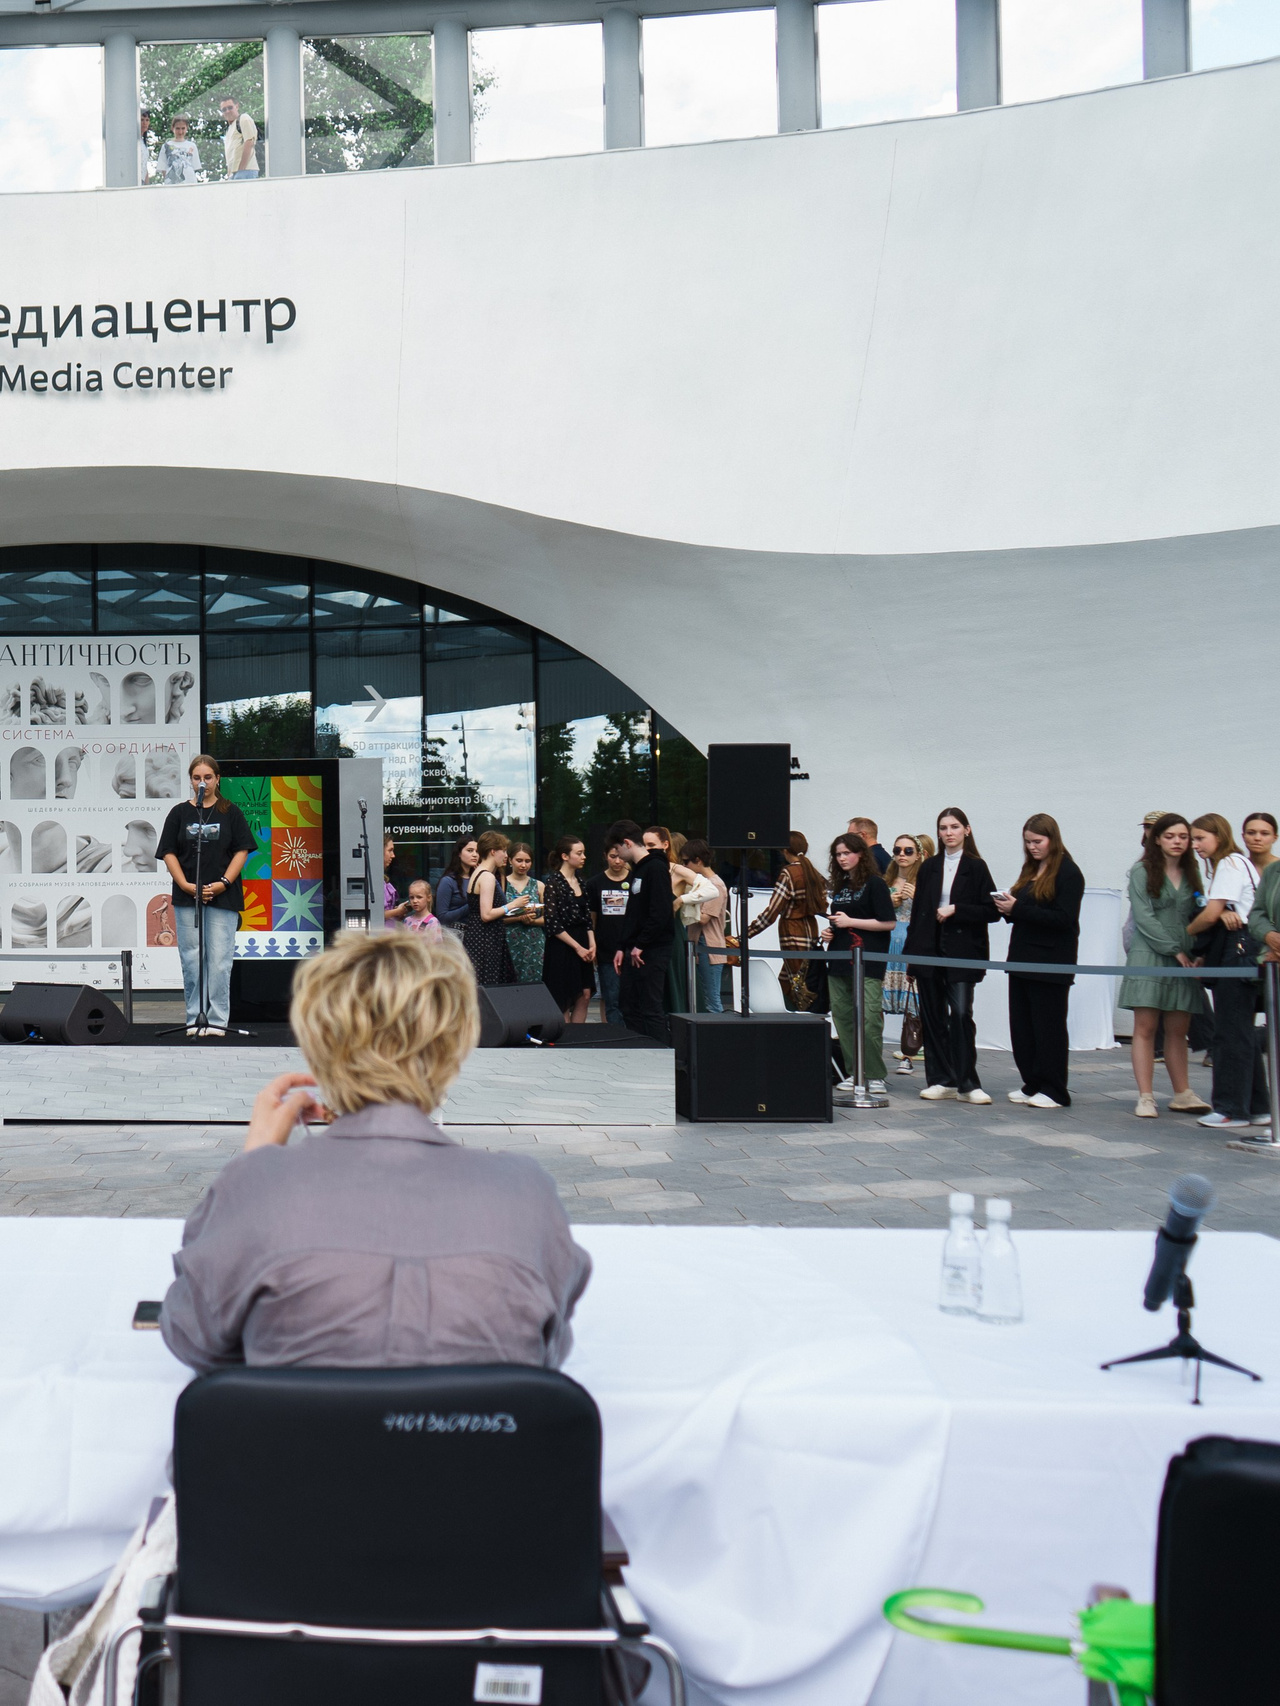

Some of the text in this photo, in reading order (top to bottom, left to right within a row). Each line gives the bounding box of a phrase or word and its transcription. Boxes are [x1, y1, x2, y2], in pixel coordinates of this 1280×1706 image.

[113, 361, 233, 389] Center
[2, 729, 75, 740] СИСТЕМА
[81, 742, 187, 755] КООРДИНАТ
[353, 742, 365, 751] 5D
[420, 796, 471, 806] кинотеатр
[392, 825, 445, 836] сувениры,
[447, 822, 474, 835] кофе
